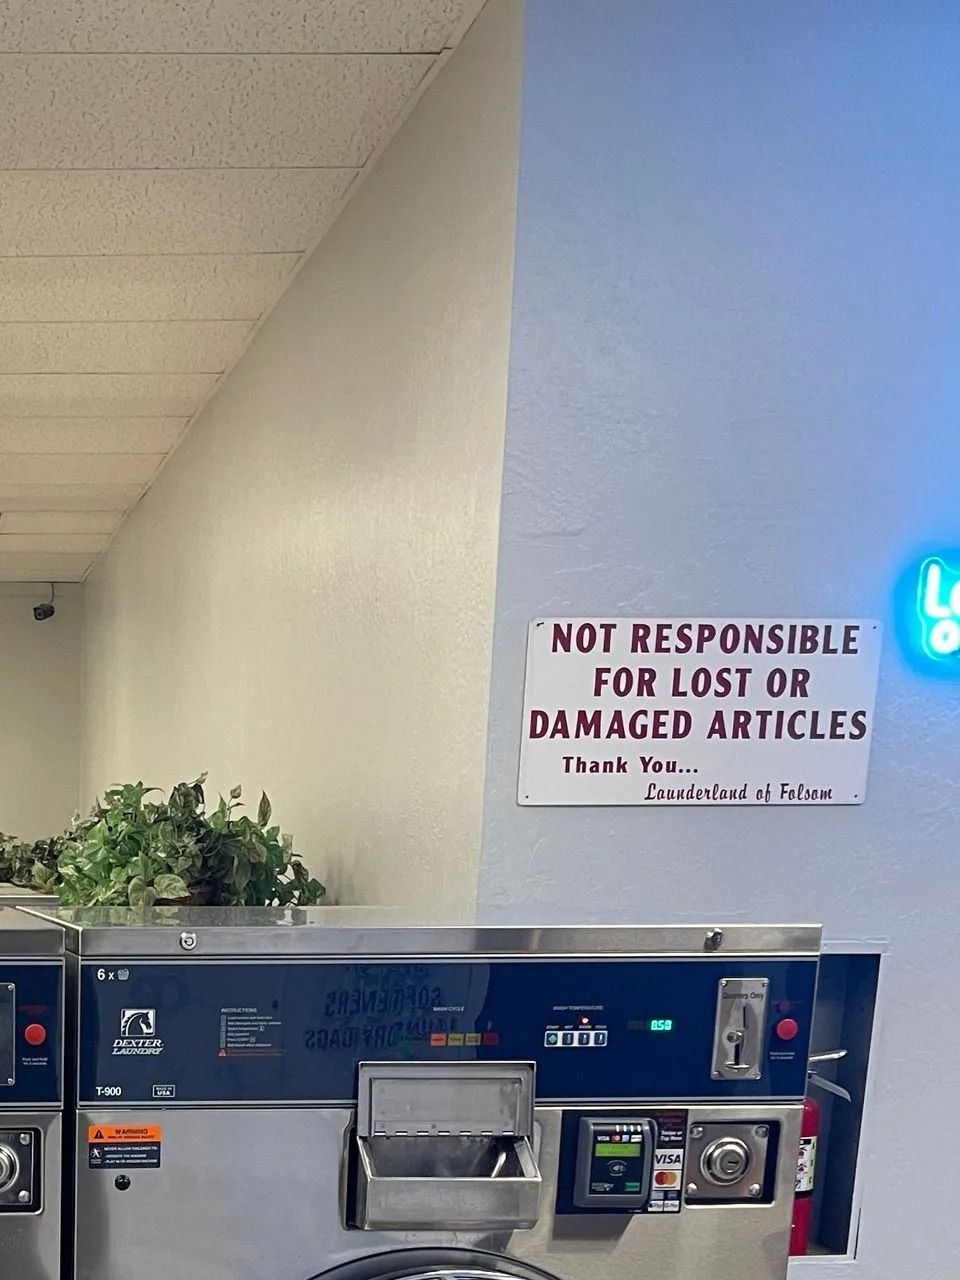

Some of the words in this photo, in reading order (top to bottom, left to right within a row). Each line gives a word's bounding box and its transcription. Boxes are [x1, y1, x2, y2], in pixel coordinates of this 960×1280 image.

[924, 563, 960, 618] L
[551, 622, 617, 654] NOT
[630, 623, 860, 655] RESPONSIBLE
[593, 667, 657, 698] FOR
[671, 667, 753, 698] LOST
[766, 667, 811, 698] OR
[529, 709, 693, 740] DAMAGED
[706, 709, 868, 741] ARTICLES
[562, 755, 628, 774] Thank
[640, 756, 699, 774] You...
[643, 782, 749, 802] Launderland
[755, 782, 772, 803] of
[779, 782, 834, 802] Folsom
[97, 968, 106, 981] 6
[108, 972, 115, 980] x
[722, 992, 749, 1000] Quarters
[750, 992, 765, 1001] Only
[112, 1039, 163, 1047] DEXTER
[96, 1086, 122, 1096] T-900
[655, 1154, 682, 1165] VISA
